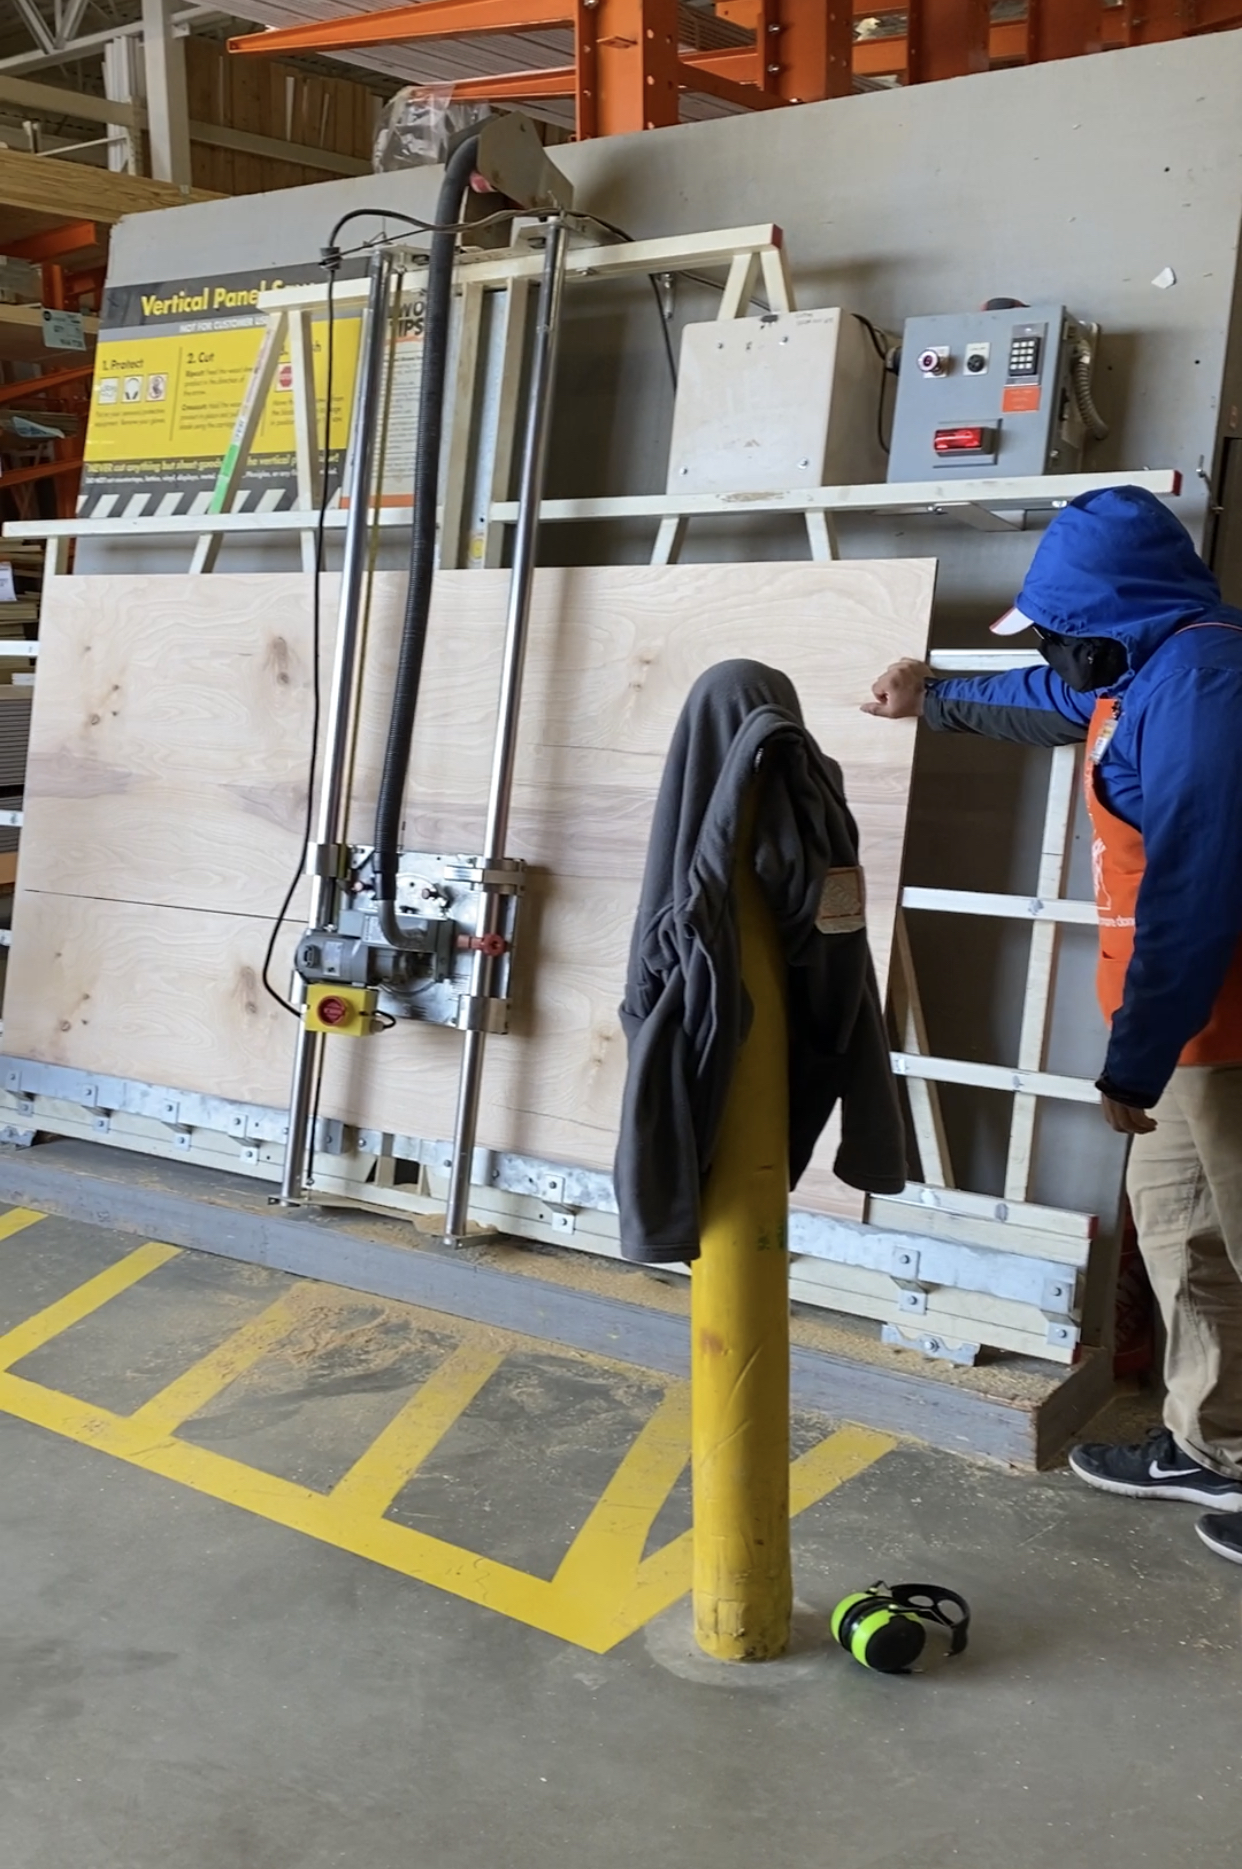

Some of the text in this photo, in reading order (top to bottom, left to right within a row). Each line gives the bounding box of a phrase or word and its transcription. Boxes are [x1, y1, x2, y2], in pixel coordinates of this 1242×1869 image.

[141, 287, 209, 317] Vertical
[179, 323, 196, 333] NOT
[196, 321, 213, 331] FOR
[213, 317, 254, 330] CUSTOMER
[198, 352, 215, 363] Cut
[110, 359, 144, 370] Protect
